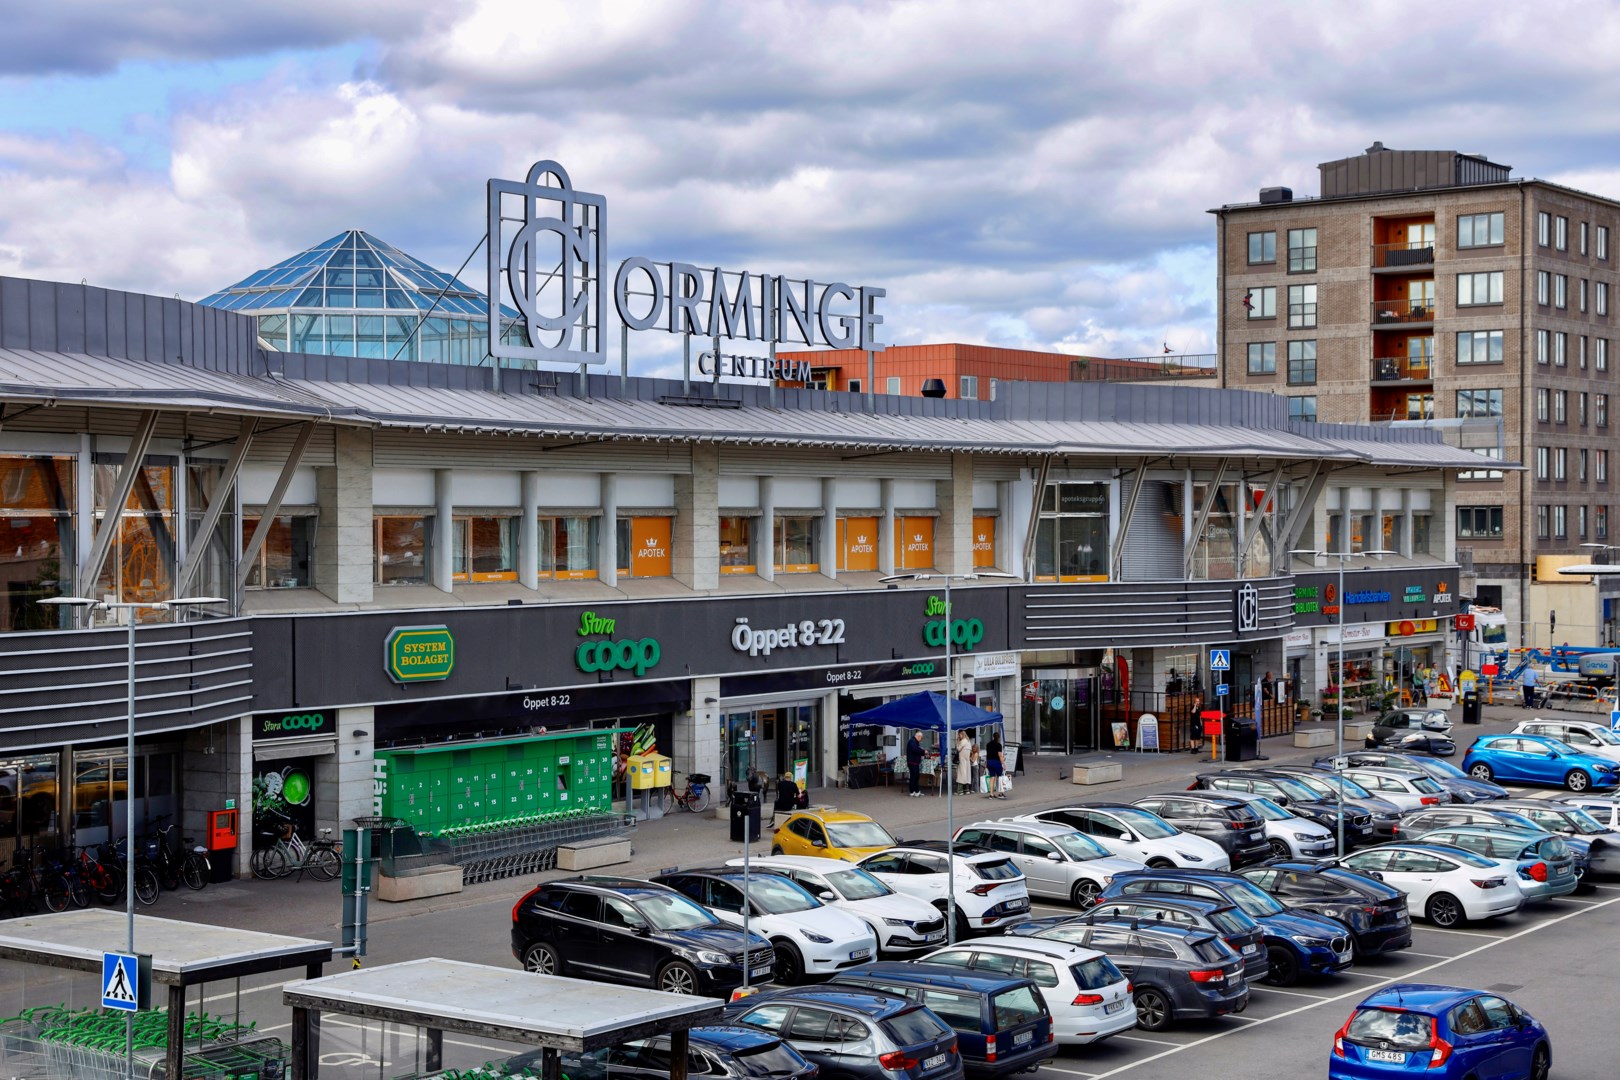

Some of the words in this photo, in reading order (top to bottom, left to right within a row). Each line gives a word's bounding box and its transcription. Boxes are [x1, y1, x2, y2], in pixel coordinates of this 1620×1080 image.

[614, 256, 887, 352] ORMINGE
[698, 352, 813, 382] CENTRUM
[638, 549, 665, 558] APOTEK
[851, 545, 873, 553] APOTEK
[907, 543, 929, 551] APOTEK
[1343, 589, 1391, 604] Handelsbanken
[1433, 593, 1452, 603] APOTEK
[1295, 601, 1318, 613] BIBLIOTEK
[578, 611, 616, 636] Stora
[731, 617, 798, 656] Öppet
[799, 618, 845, 646] 8-22
[923, 617, 984, 651] coop
[404, 642, 446, 653] SYSTEM
[401, 654, 449, 666] BOLAGET
[576, 637, 661, 677] coop
[911, 663, 935, 675] coop
[826, 670, 846, 683] Öppet
[847, 670, 862, 680] 8-22
[523, 696, 549, 710] Öppet
[551, 695, 570, 706] 8-22
[263, 720, 281, 732] Stora
[281, 713, 324, 731] coop
[1371, 1050, 1386, 1059] GMS
